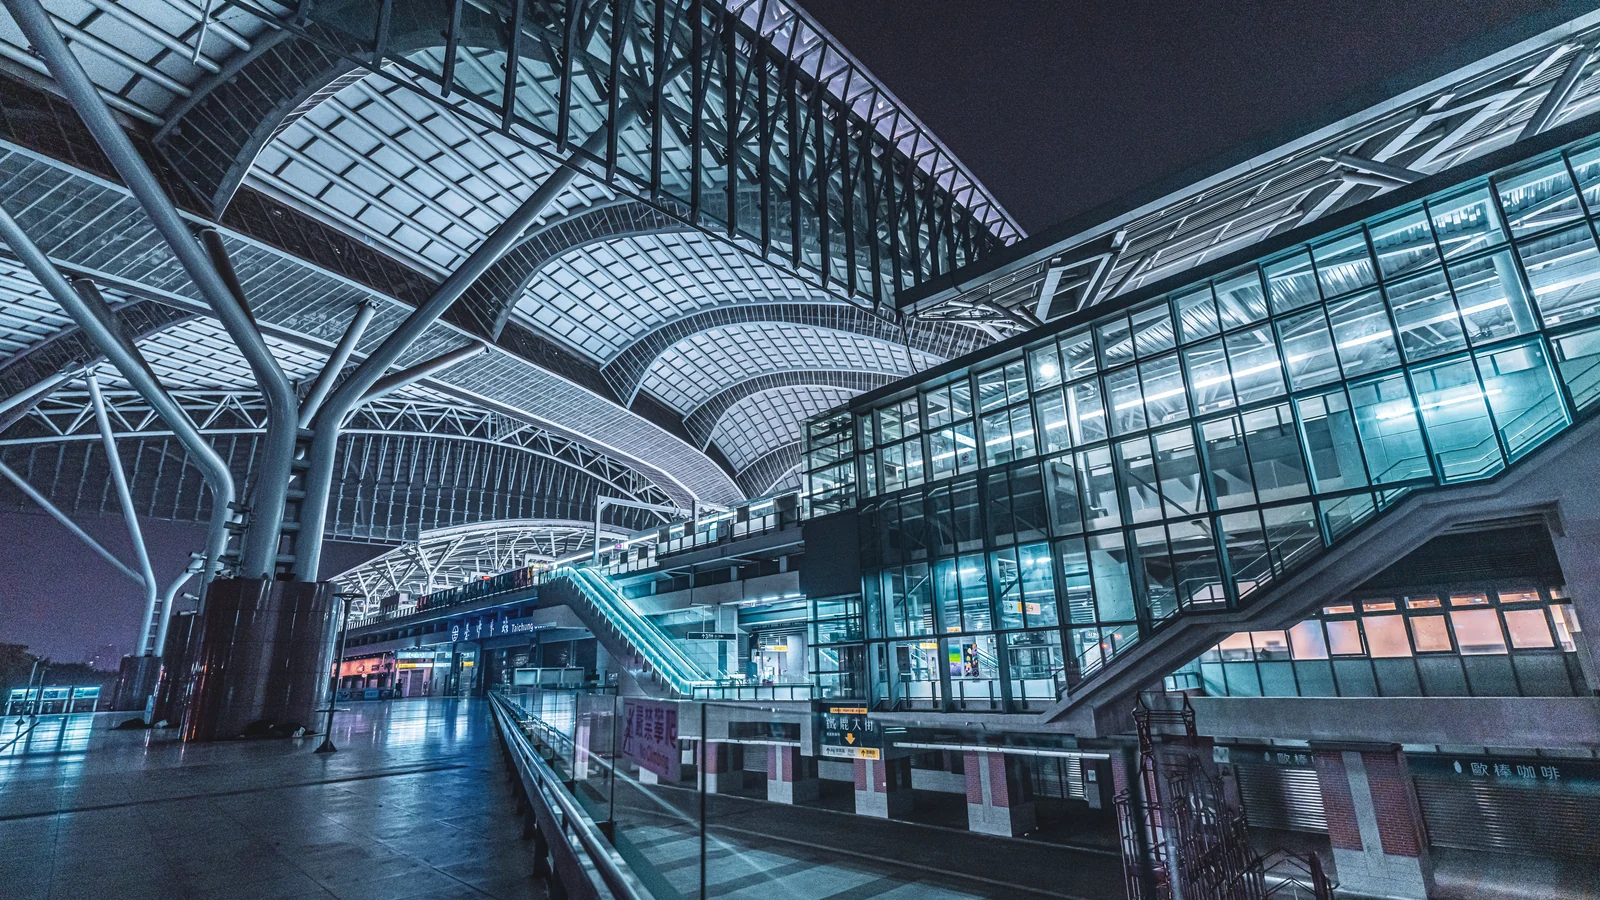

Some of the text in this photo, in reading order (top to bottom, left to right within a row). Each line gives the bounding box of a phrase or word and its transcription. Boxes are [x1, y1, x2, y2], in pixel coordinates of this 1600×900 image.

[511, 622, 534, 632] Taichung
[1470, 762, 1561, 780] 歐棒咖啡
